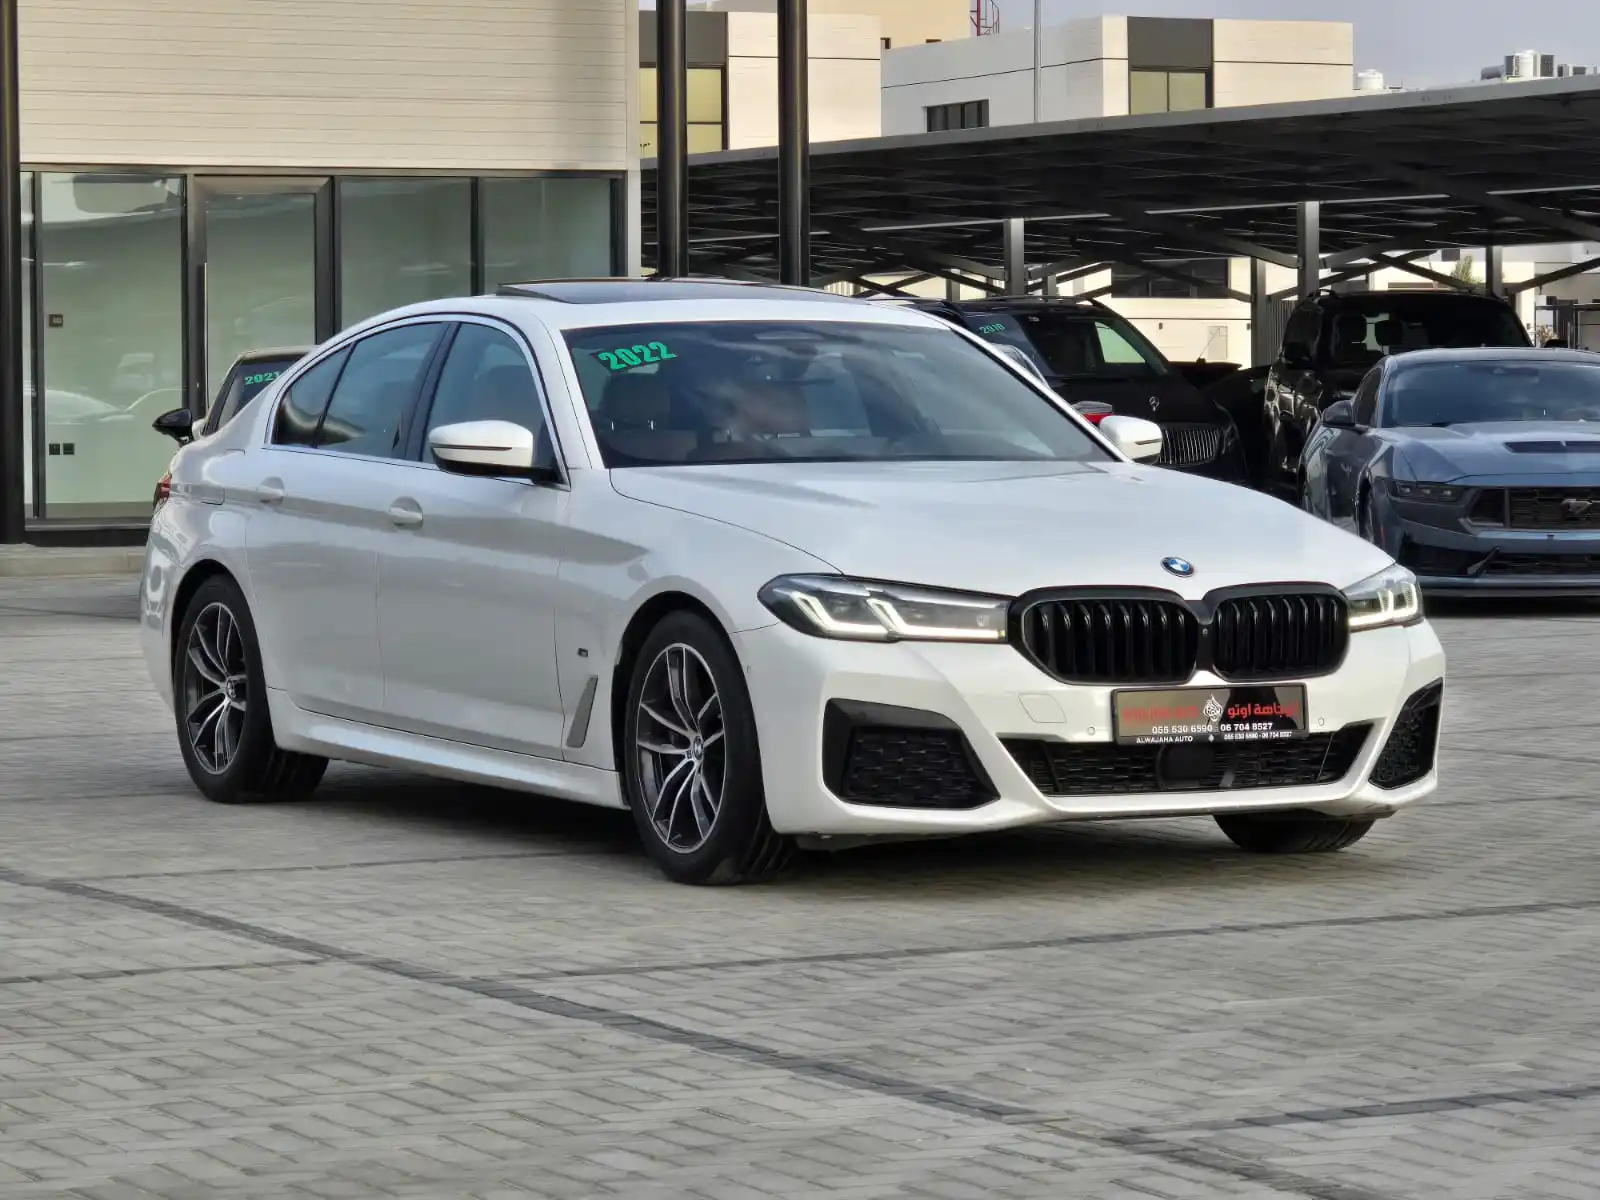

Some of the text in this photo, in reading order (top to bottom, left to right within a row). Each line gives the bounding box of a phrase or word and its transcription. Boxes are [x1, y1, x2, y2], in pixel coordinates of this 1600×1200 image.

[598, 341, 677, 370] 2022
[1151, 722, 1273, 734] 055 530 6590 06 704 8527
[1174, 735, 1194, 743] AUTO
